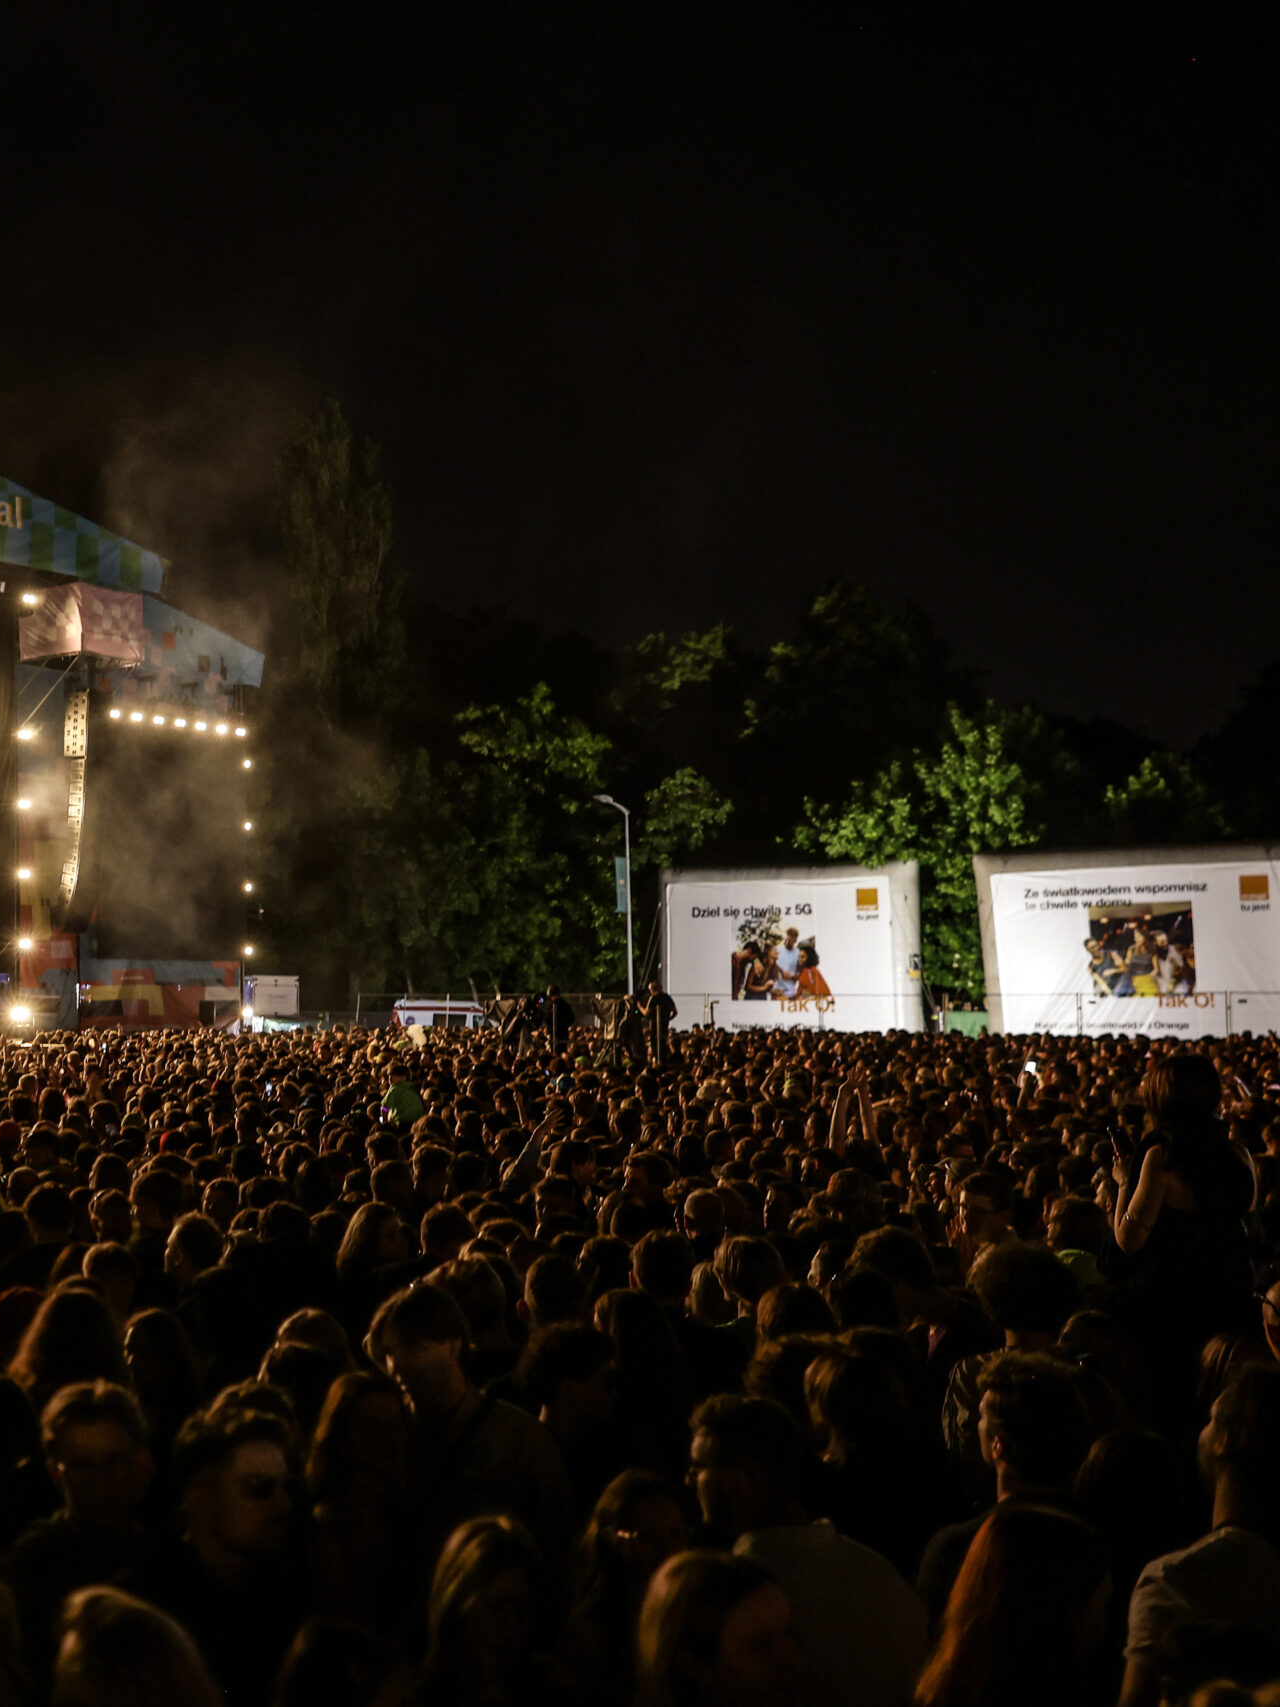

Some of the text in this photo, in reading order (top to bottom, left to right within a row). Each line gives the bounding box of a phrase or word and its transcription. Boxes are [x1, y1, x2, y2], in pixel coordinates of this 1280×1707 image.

[1024, 888, 1039, 899] Ze
[1134, 882, 1208, 896] wspomnisz
[691, 906, 720, 918] Dziel
[723, 906, 740, 919] się
[784, 906, 792, 916] z
[795, 903, 813, 916] 5G
[1039, 900, 1078, 911] chwile
[1081, 901, 1093, 909] w
[1095, 898, 1132, 909] domu
[780, 996, 808, 1013] Tak
[1156, 993, 1216, 1008] Tak O!
